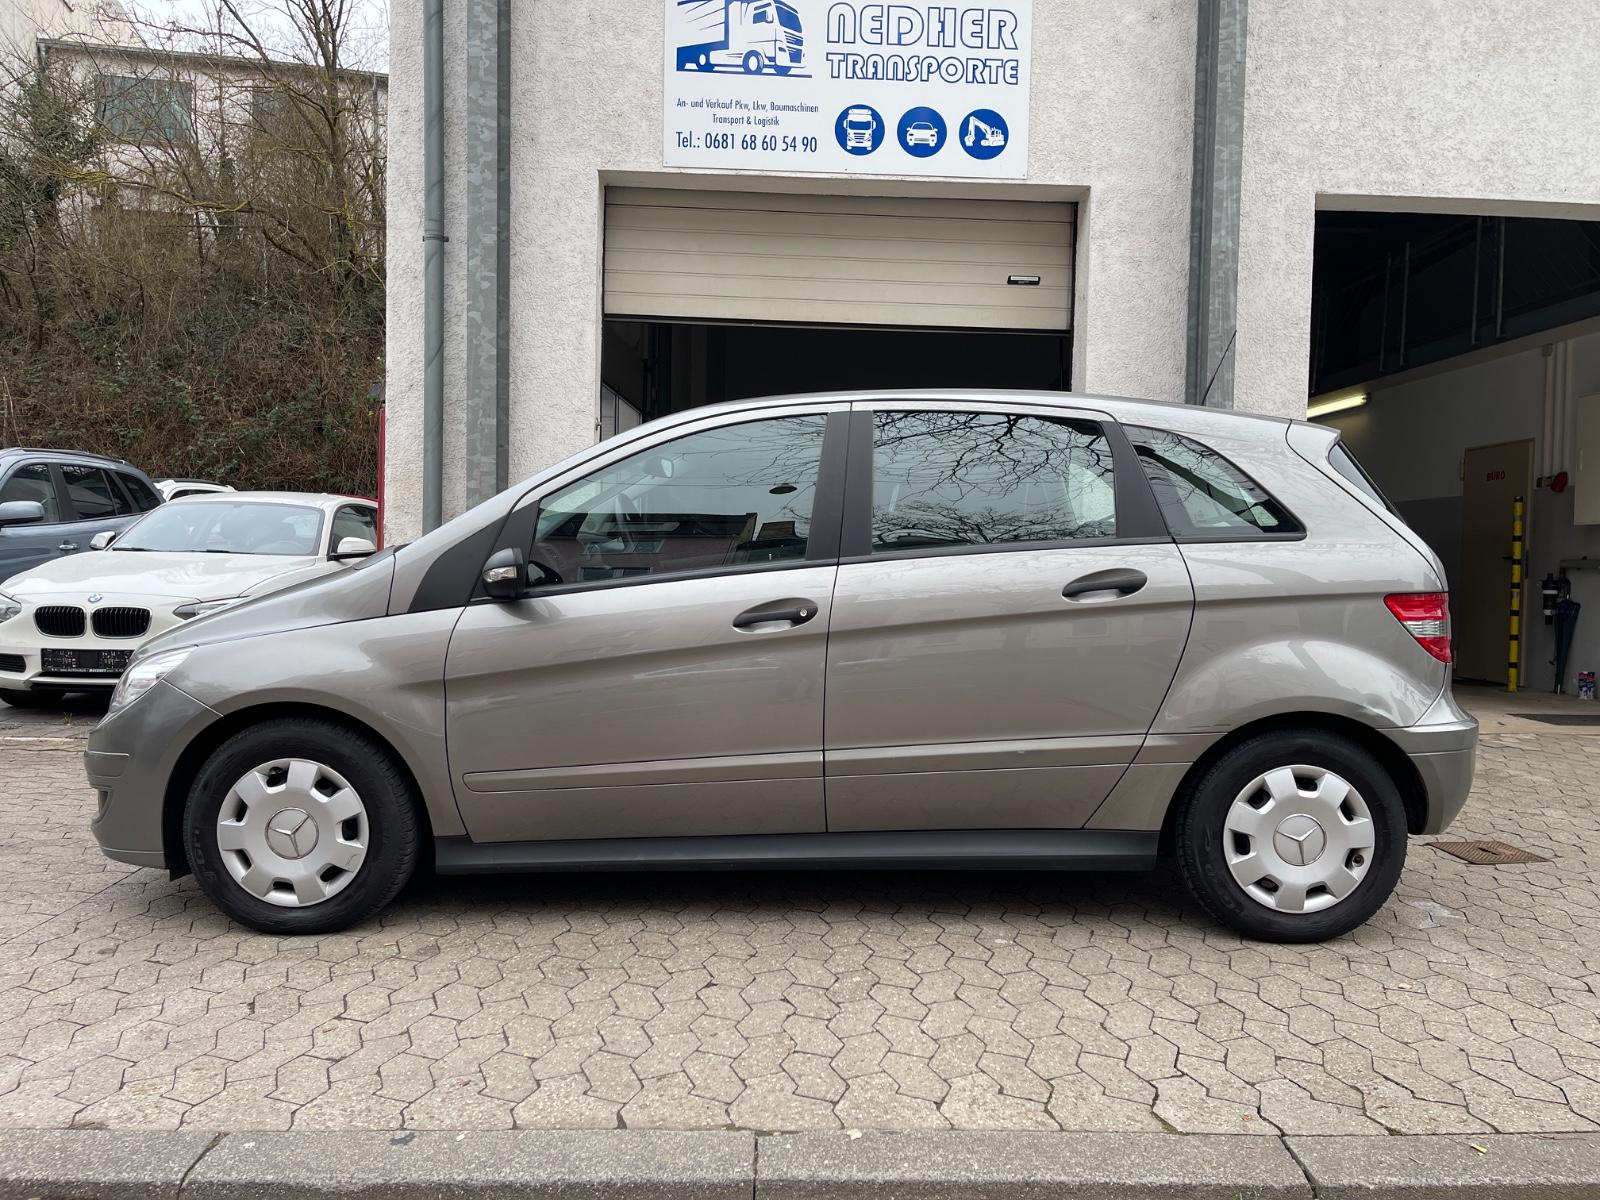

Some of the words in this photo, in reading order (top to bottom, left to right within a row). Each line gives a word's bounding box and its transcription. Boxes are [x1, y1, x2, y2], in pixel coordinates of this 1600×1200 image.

[826, 2, 1018, 50] NEDHER
[826, 52, 1019, 86] TRANSPORTE
[676, 98, 689, 108] An-
[690, 98, 704, 108] und
[705, 99, 733, 111] Verkauf
[734, 100, 750, 112] Pkw,
[752, 101, 768, 113] Lkw,
[770, 101, 819, 113] Baumaschinen
[712, 113, 744, 126] Transport
[746, 116, 752, 125] &
[753, 115, 780, 128] Logistik
[675, 130, 701, 149] Tel.:
[704, 132, 735, 150] 0681
[741, 134, 757, 151] 68
[761, 135, 777, 152] 60
[781, 135, 797, 152] 54
[801, 136, 818, 153] 90
